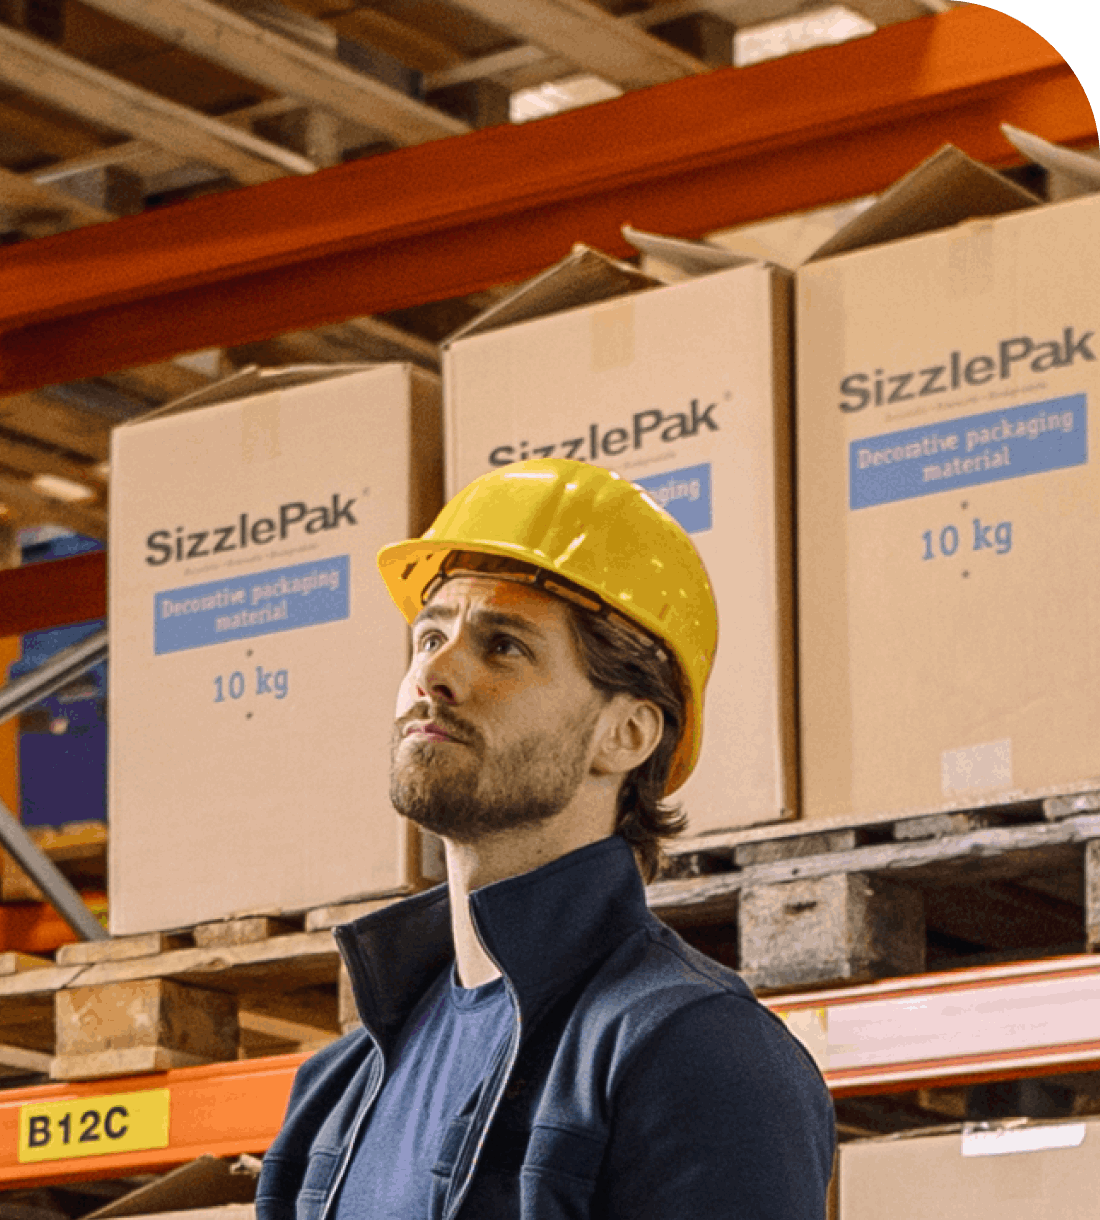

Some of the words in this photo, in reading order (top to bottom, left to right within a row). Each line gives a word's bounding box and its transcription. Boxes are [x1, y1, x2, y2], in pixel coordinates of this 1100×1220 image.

[838, 325, 1097, 414] SizzlePak
[856, 432, 960, 470] Decorative
[965, 410, 1074, 453] packaging
[921, 443, 1012, 482] material
[144, 493, 358, 567] SizzlePak
[921, 523, 960, 561] 10
[971, 517, 1013, 556] kg
[160, 586, 247, 620] Decorative
[252, 569, 340, 606] packaging
[214, 600, 289, 633] material
[212, 670, 246, 703] 10
[255, 665, 290, 700] kg
[28, 1105, 129, 1148] B12C
